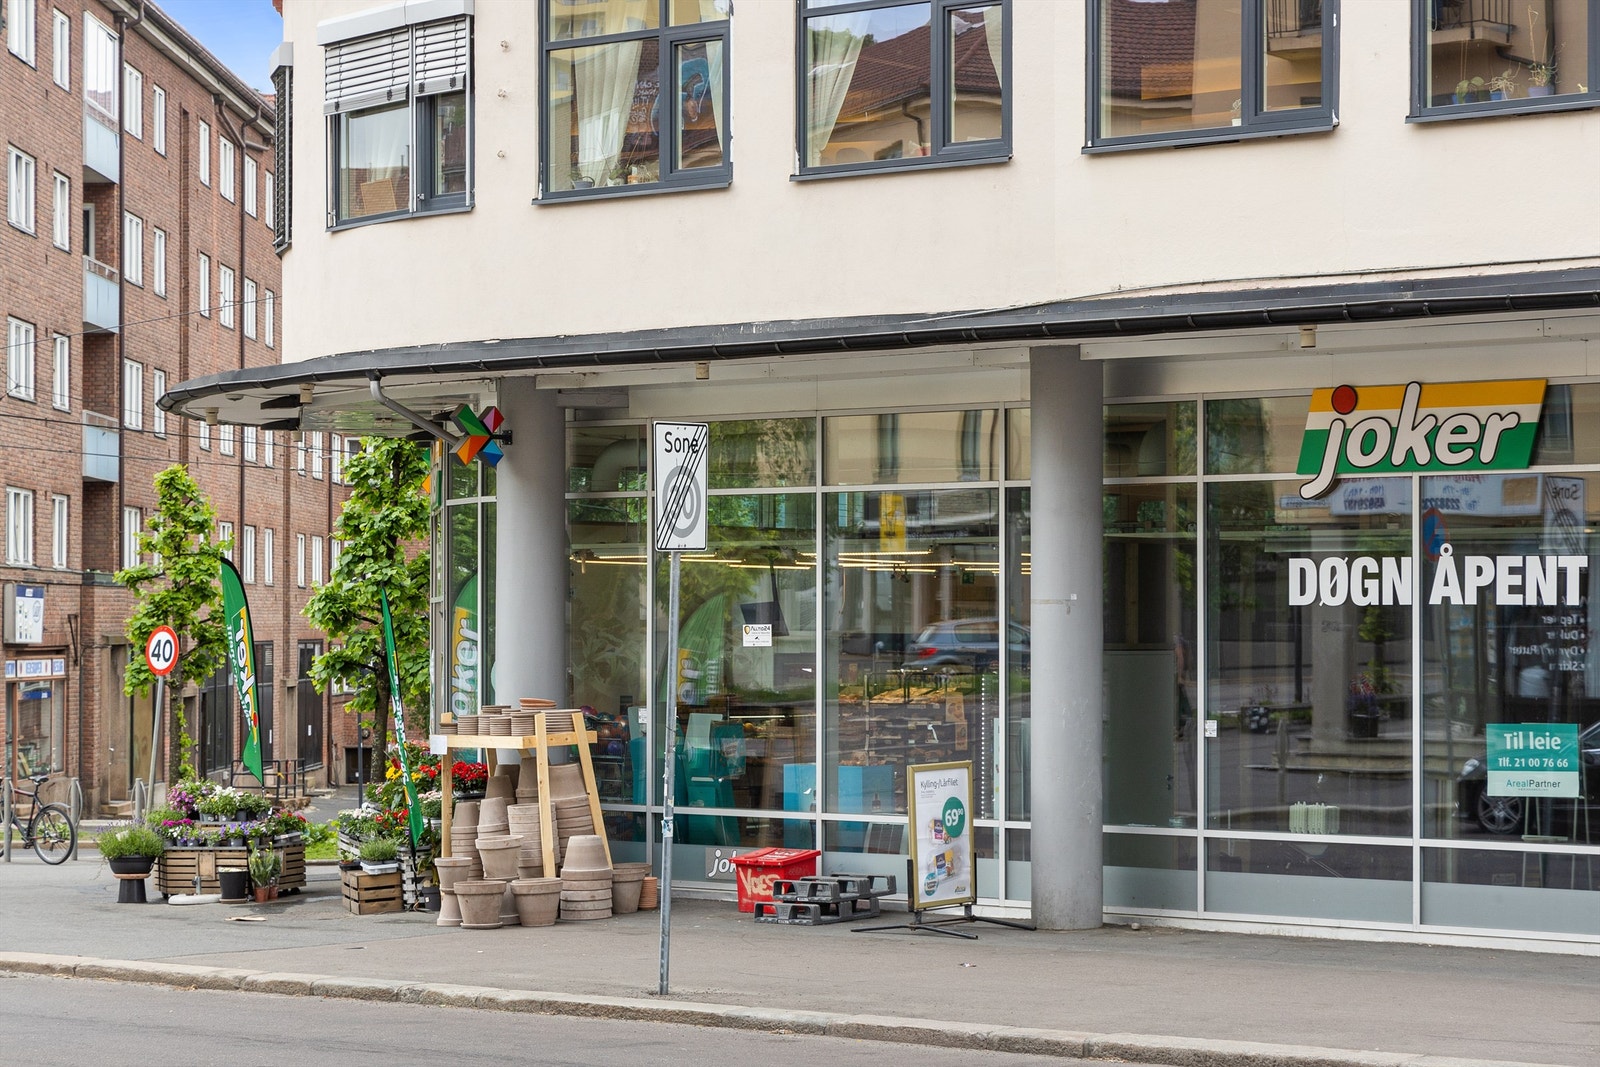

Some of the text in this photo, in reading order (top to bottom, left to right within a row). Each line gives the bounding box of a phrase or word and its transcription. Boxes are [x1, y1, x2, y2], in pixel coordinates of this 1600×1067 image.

[664, 431, 699, 454] Sone
[1299, 381, 1521, 500] joker
[1288, 543, 1588, 608] DØGN ÅPENT
[151, 639, 173, 663] 40
[451, 617, 478, 718] oker
[1503, 731, 1561, 750] Til leie
[1498, 757, 1569, 768] Tlf. 21 00 76 66
[1506, 779, 1561, 788] ArealPartner
